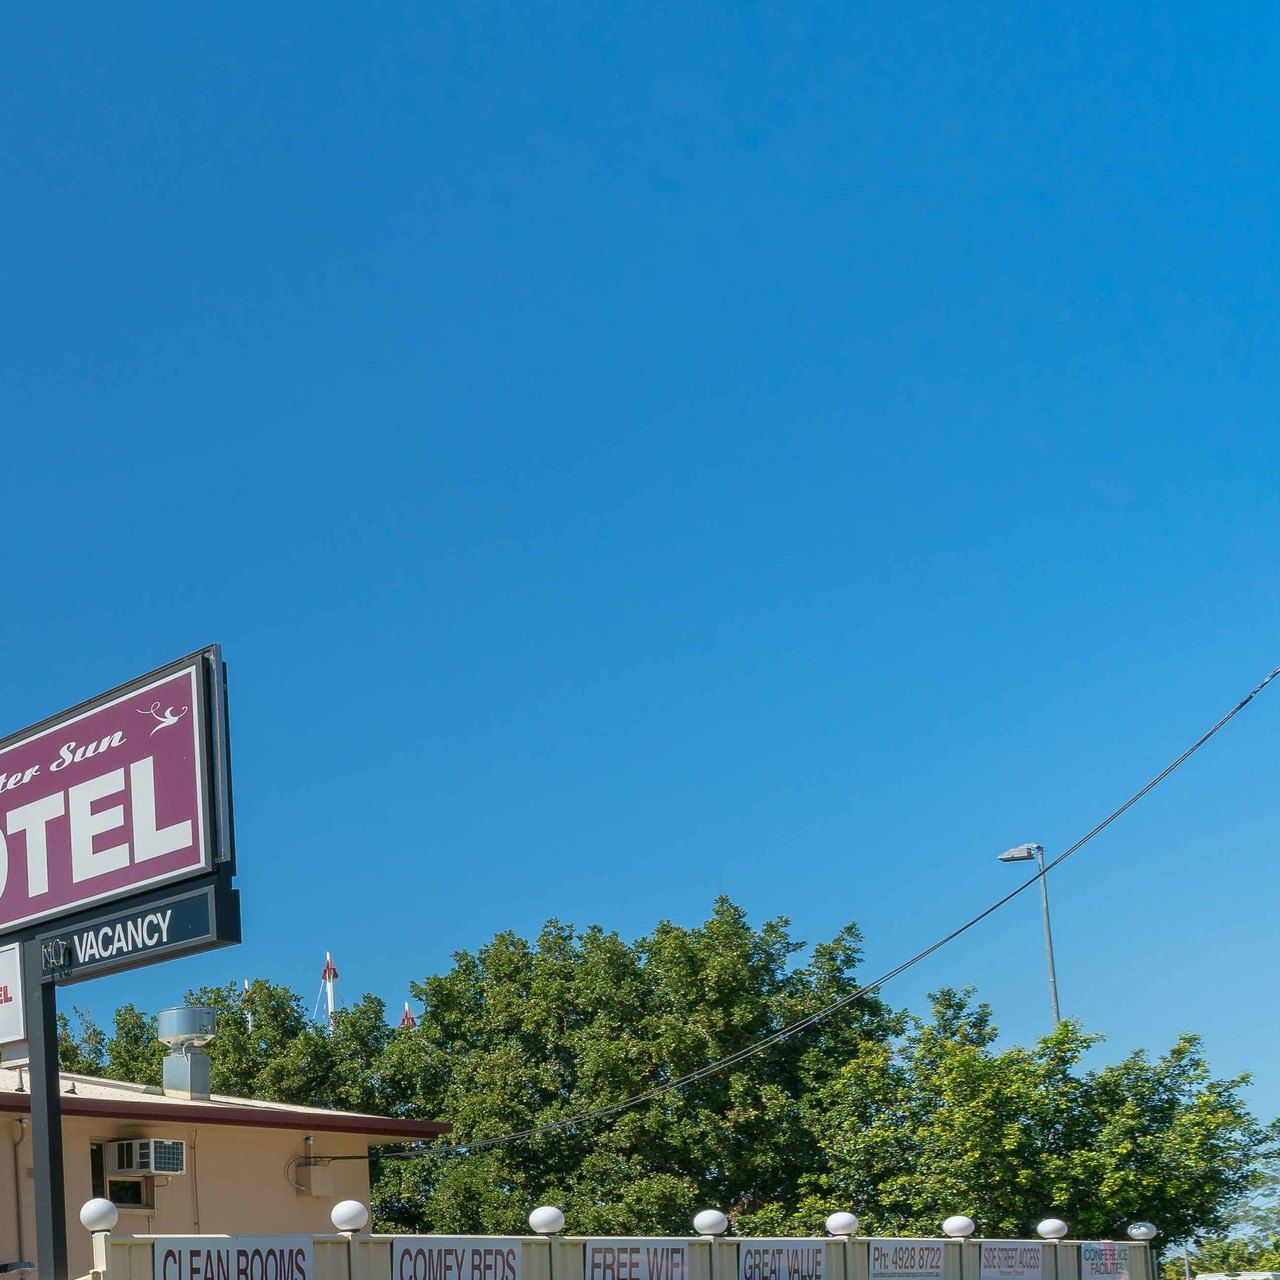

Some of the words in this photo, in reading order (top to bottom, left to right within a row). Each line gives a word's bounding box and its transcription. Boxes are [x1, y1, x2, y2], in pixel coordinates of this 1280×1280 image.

[49, 729, 126, 772] Sun
[73, 909, 172, 963] VACANCY
[787, 1248, 822, 1280] VALUE
[873, 1247, 888, 1269] Ph:
[892, 1247, 915, 1269] 4928
[918, 1247, 940, 1269] 8722
[984, 1248, 996, 1268] SIDE
[998, 1248, 1018, 1268] STREET
[1020, 1248, 1040, 1268] ACCESS
[1084, 1249, 1128, 1261] CONFERENCE
[1091, 1263, 1123, 1275] FACILITIES
